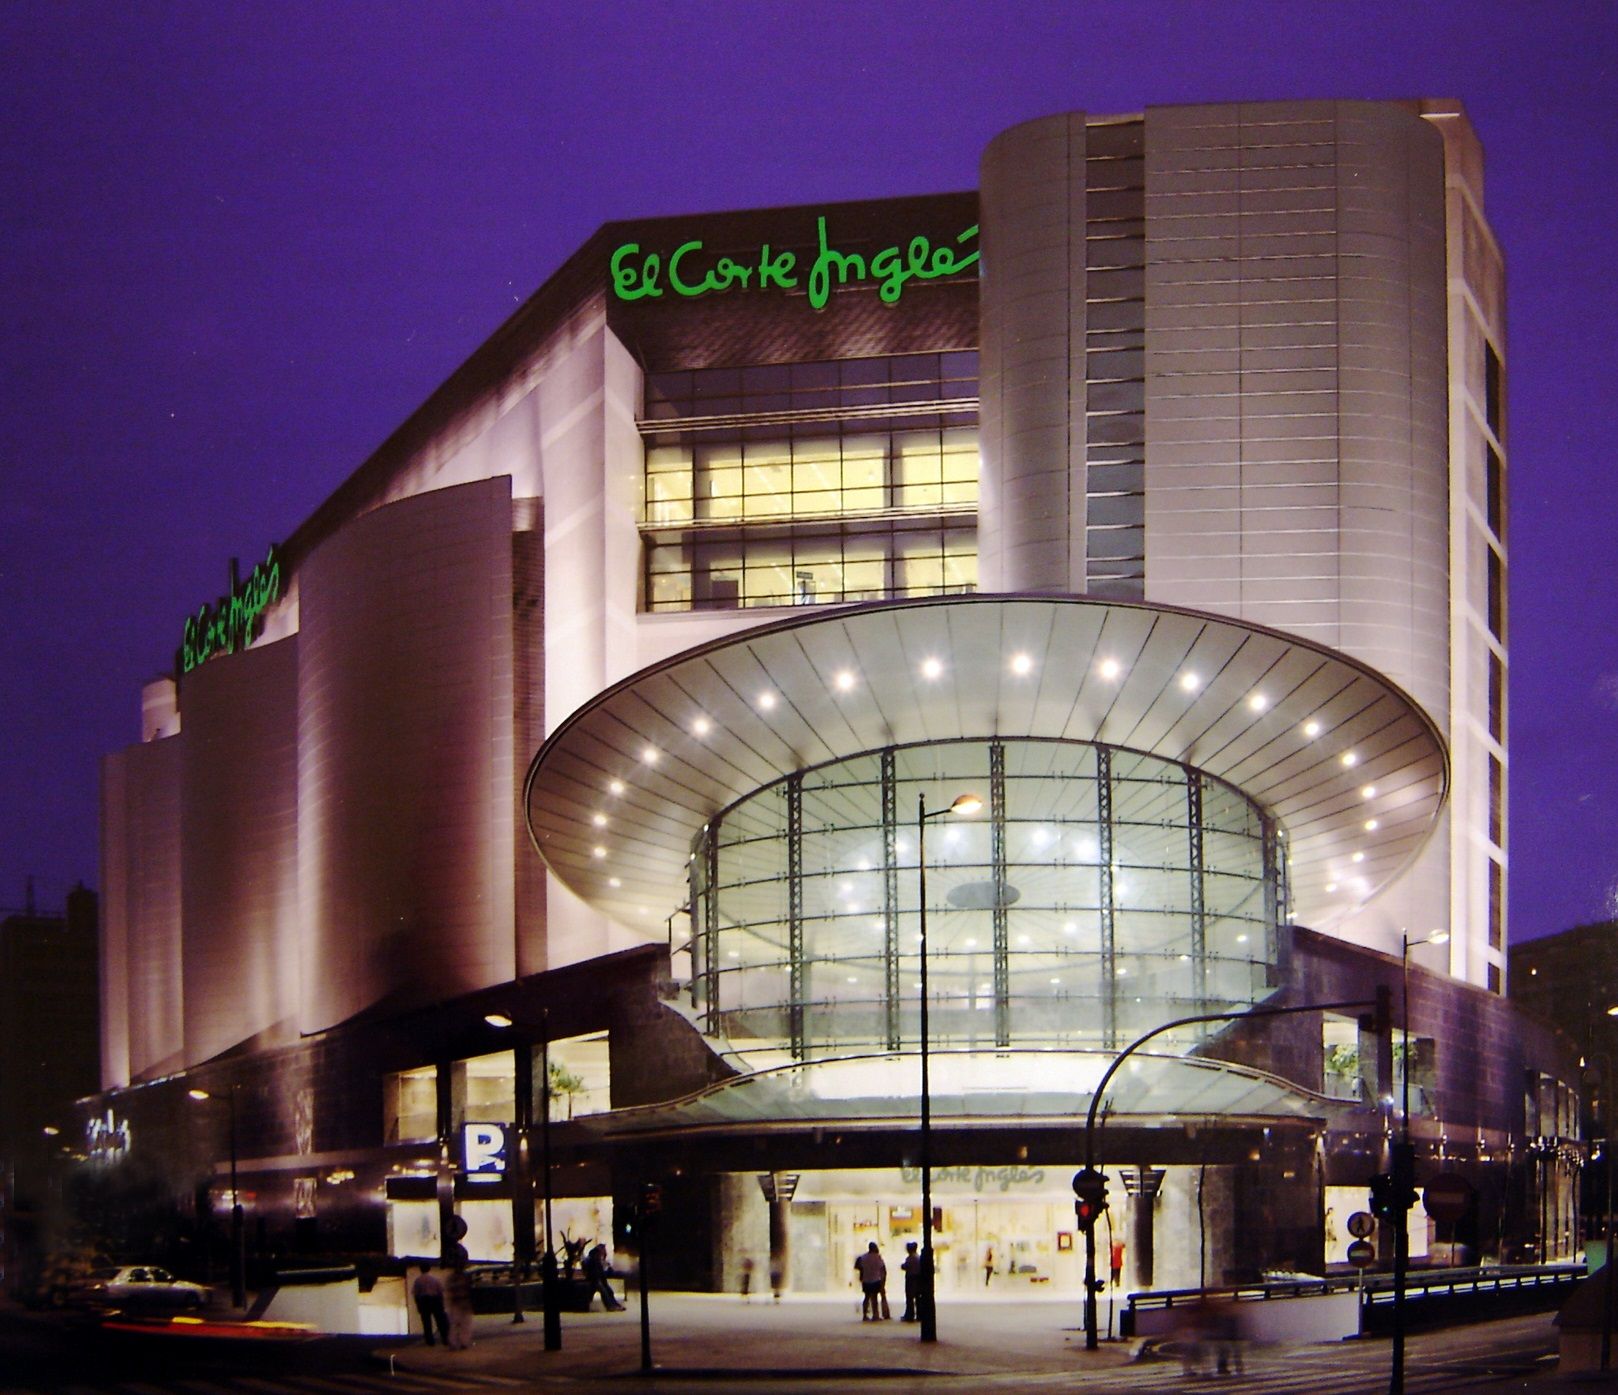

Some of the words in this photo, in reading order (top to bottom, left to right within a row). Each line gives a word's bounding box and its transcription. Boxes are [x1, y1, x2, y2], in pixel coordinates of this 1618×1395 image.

[610, 243, 663, 300] El
[668, 240, 798, 297] Corte
[808, 216, 980, 309] Inglé
